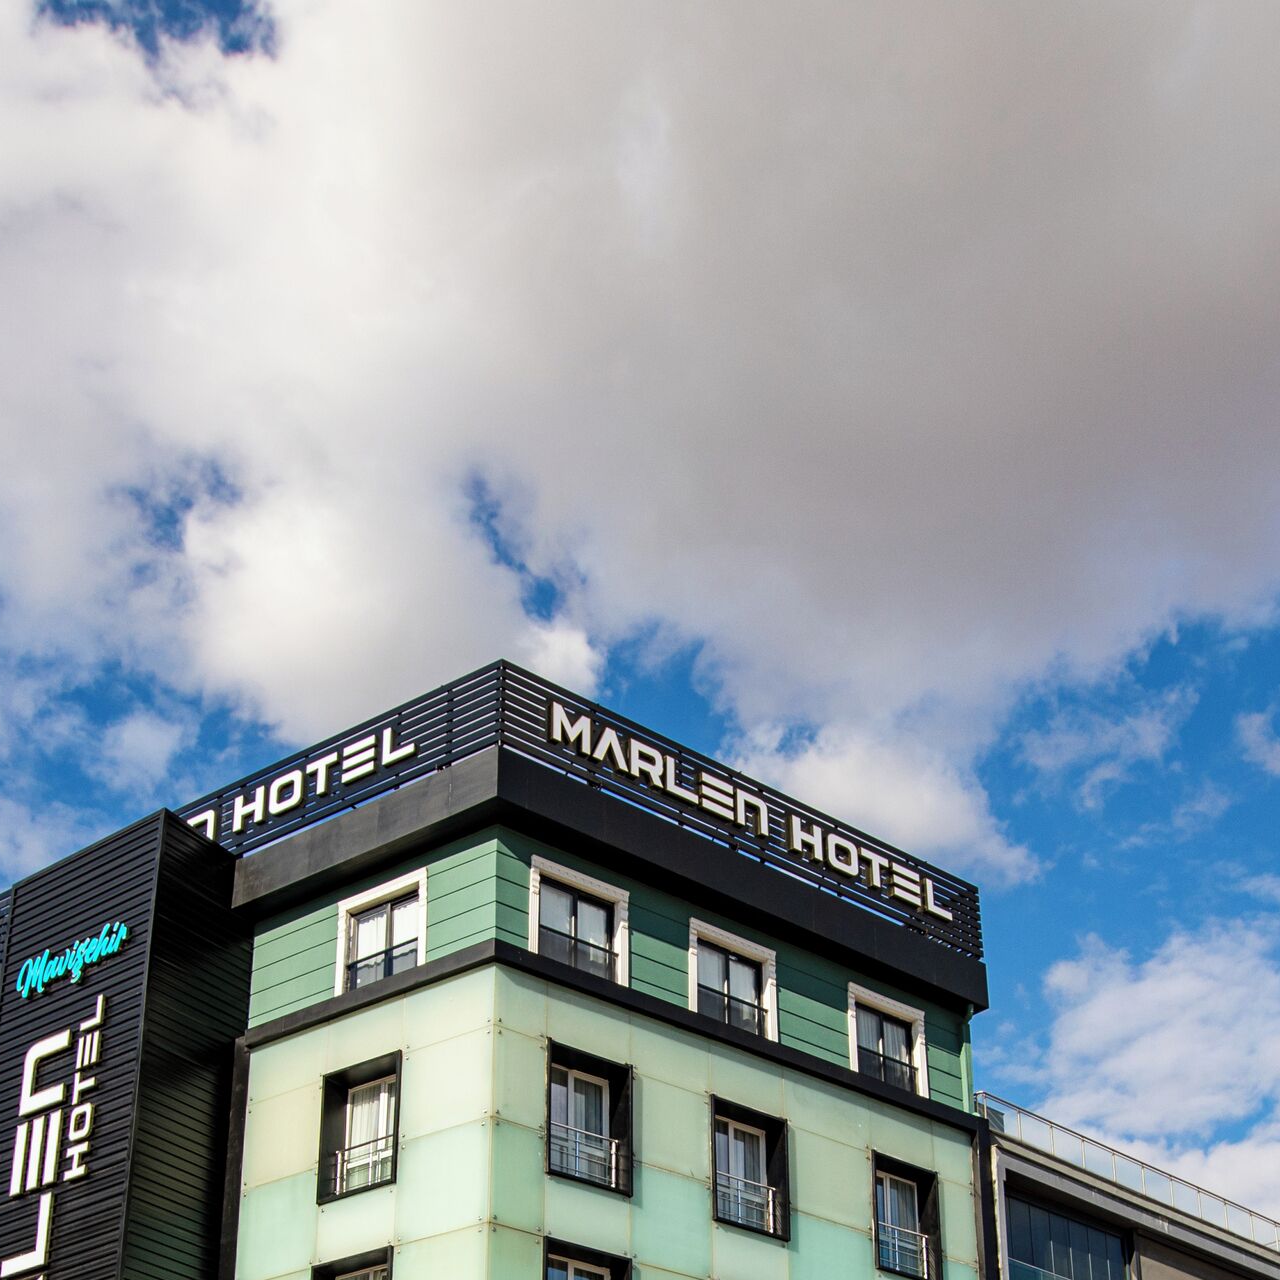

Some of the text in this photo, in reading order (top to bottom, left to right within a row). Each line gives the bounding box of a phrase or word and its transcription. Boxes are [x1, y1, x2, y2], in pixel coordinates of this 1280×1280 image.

[232, 727, 417, 834] HOTEL
[549, 701, 953, 922] MARLEN HOTEL
[16, 921, 128, 999] Mavişehir
[63, 994, 105, 1182] HOTEL
